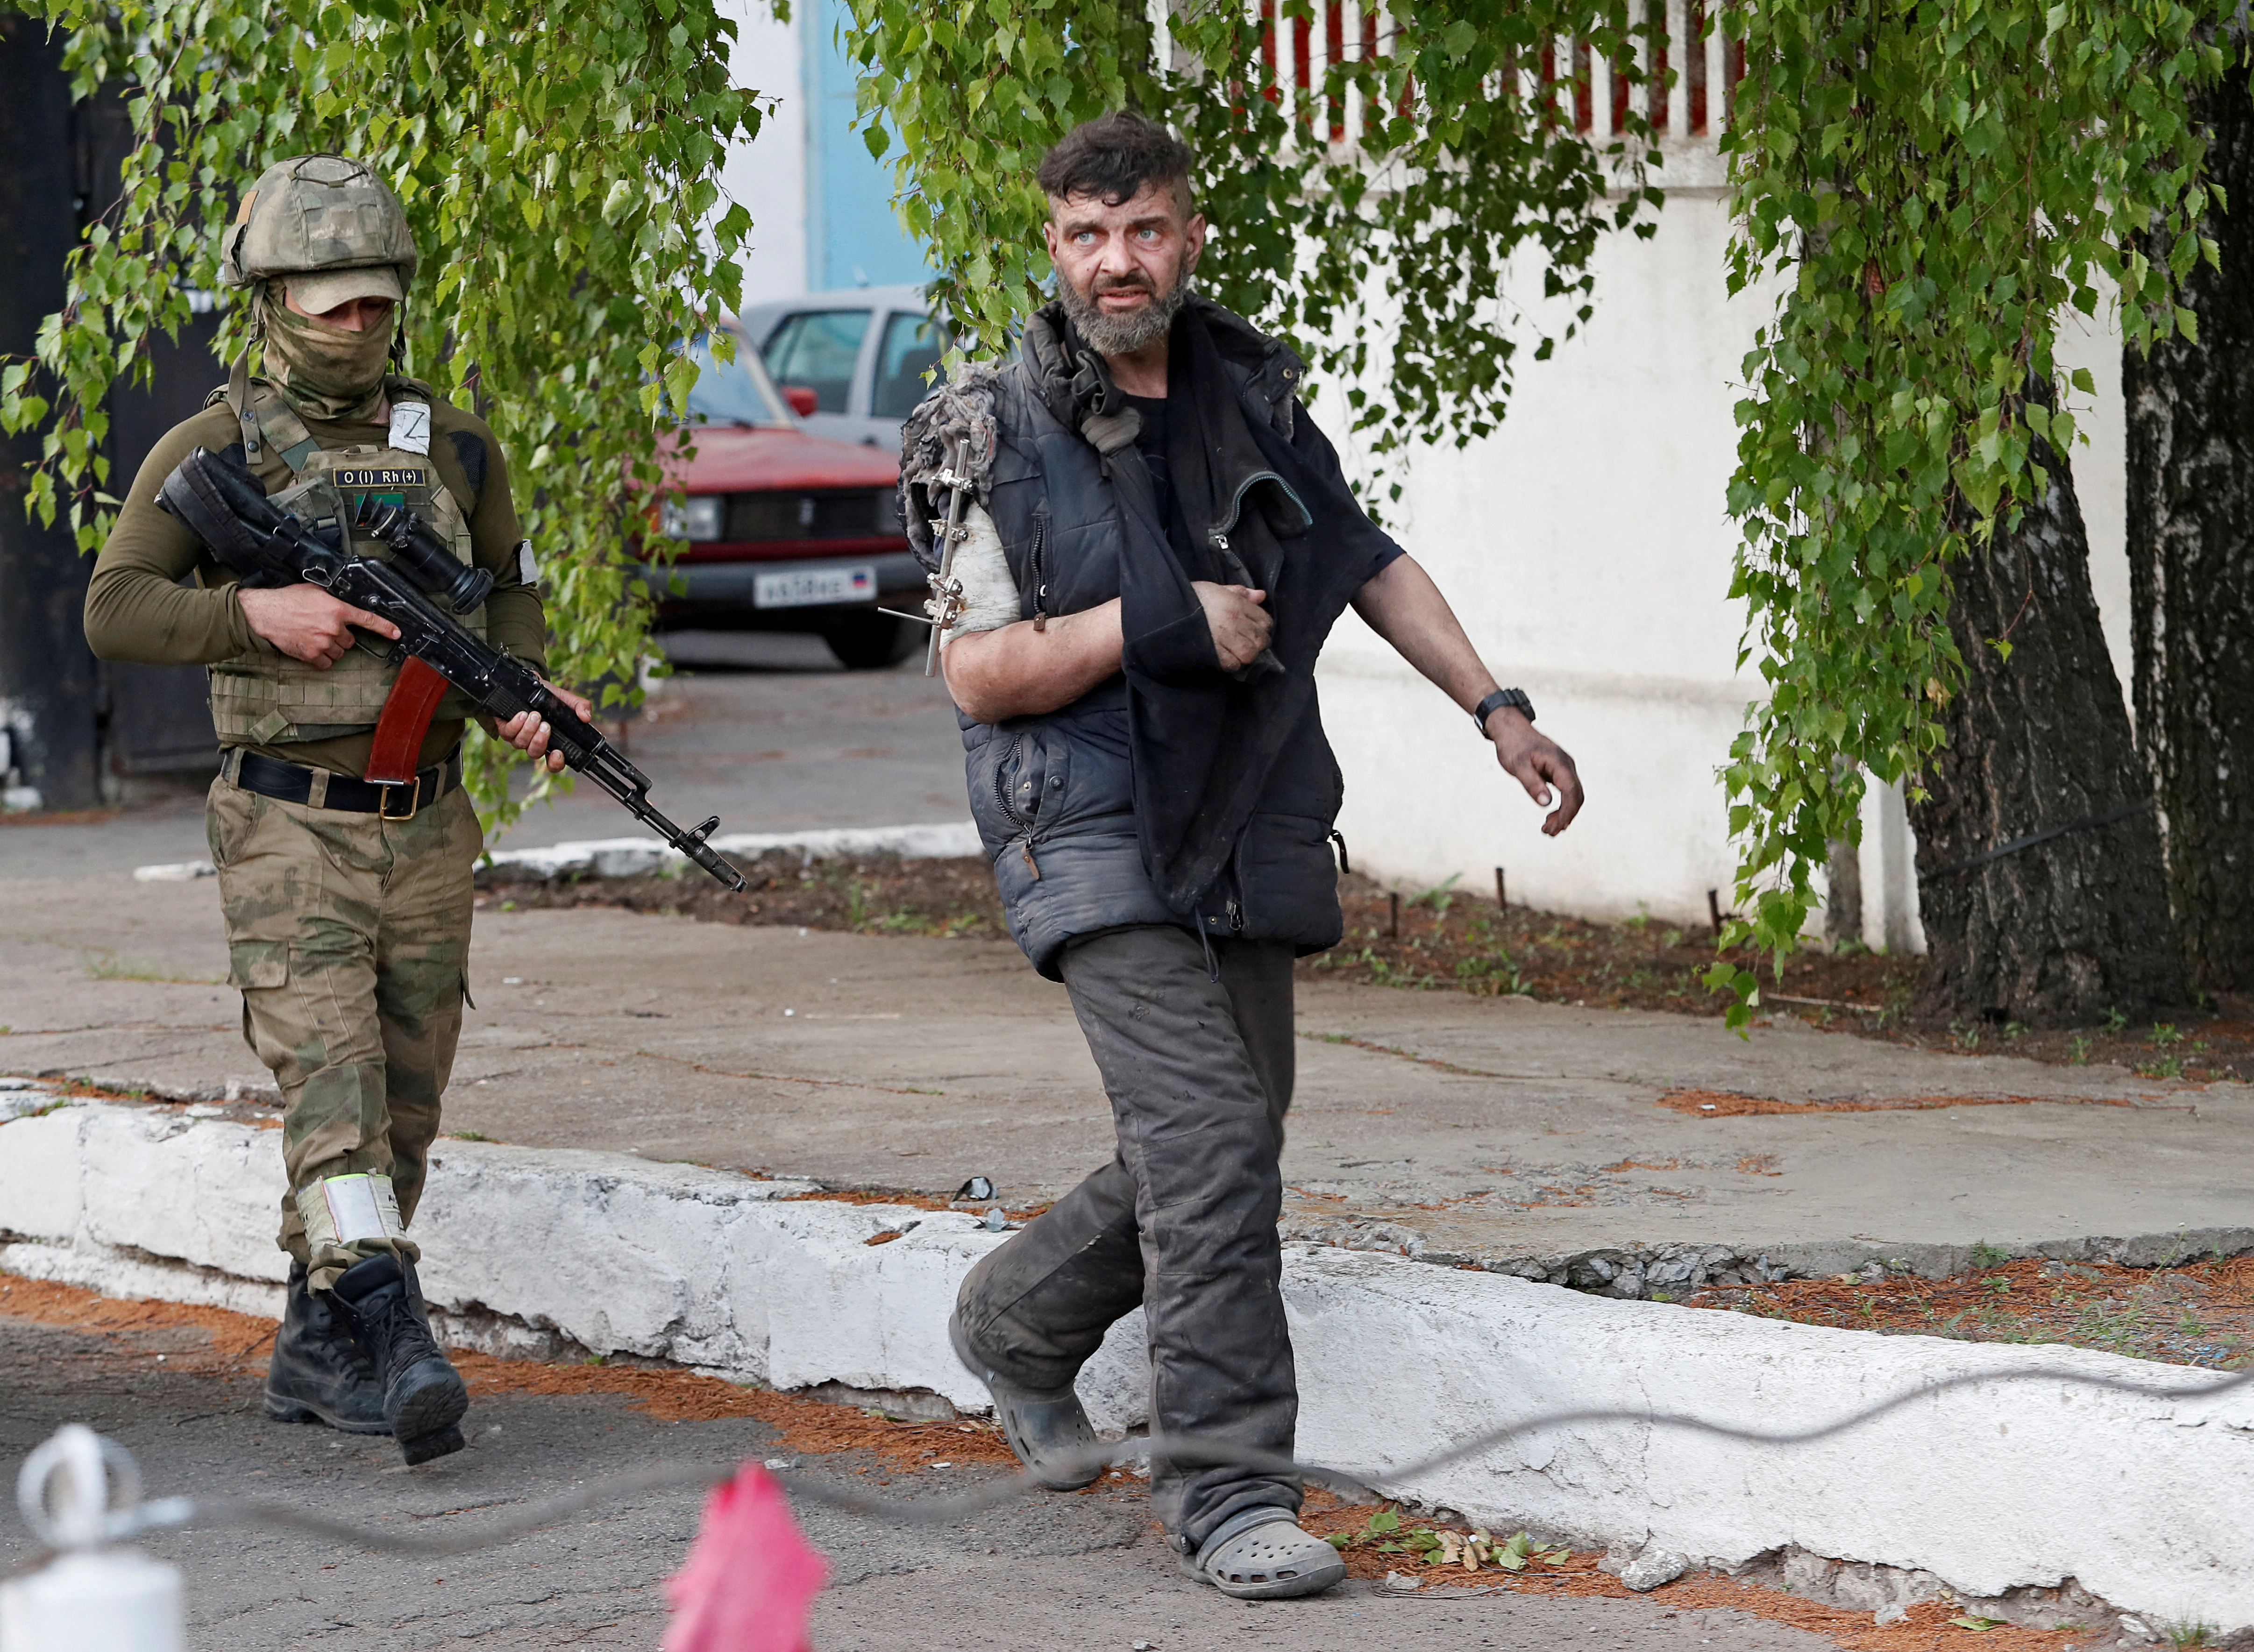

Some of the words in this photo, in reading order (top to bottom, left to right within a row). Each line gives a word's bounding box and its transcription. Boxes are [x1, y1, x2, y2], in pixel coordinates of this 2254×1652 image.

[394, 408, 429, 439] Z
[359, 470, 373, 484] (I)
[382, 471, 399, 483] Rh
[402, 470, 416, 484] (+)
